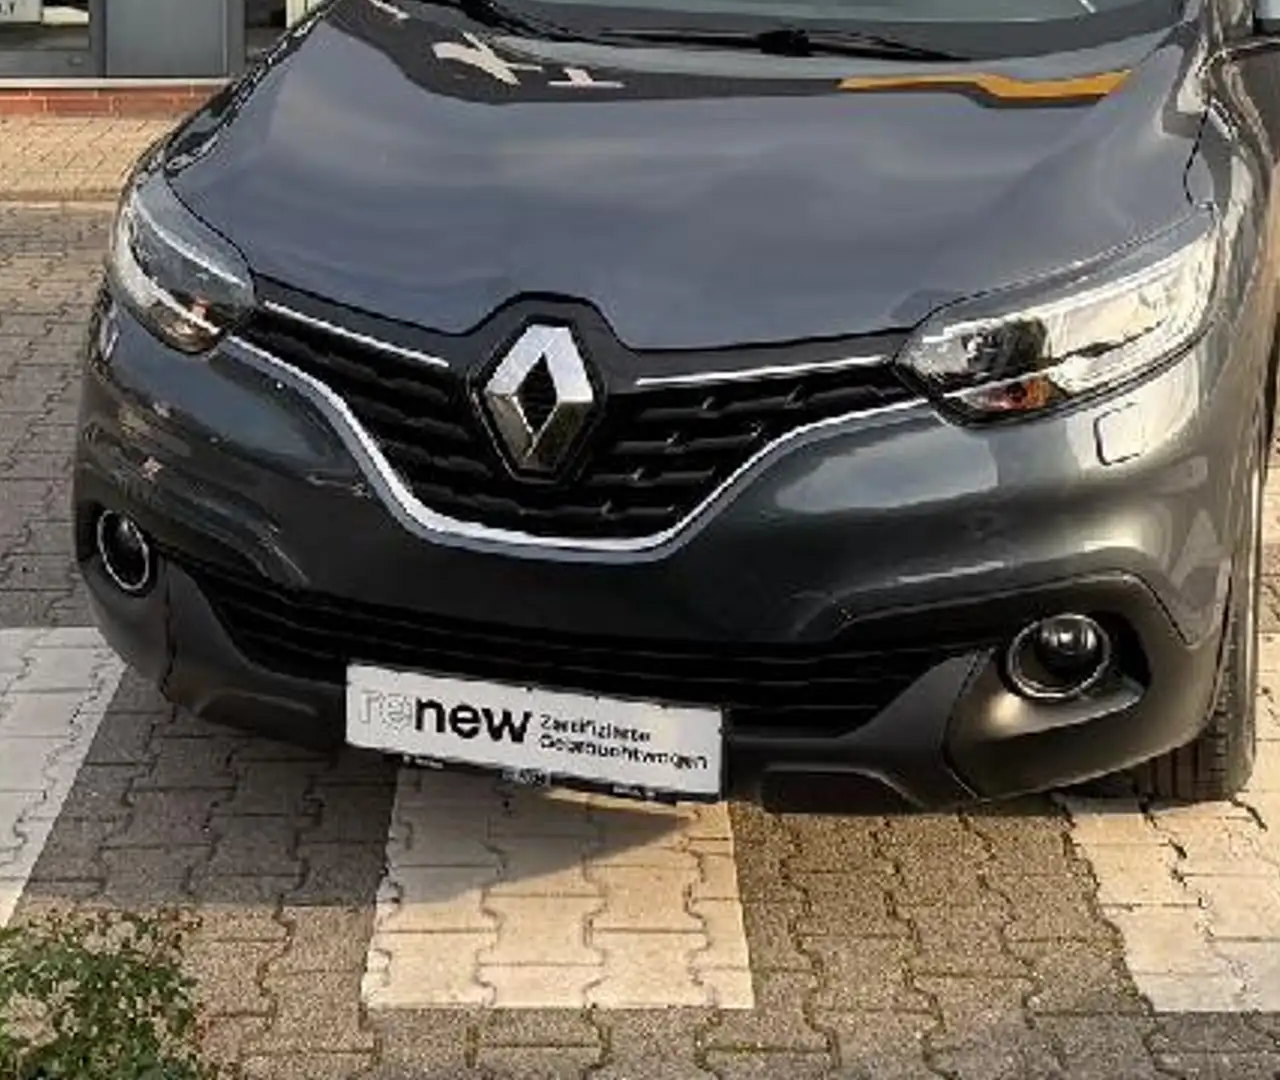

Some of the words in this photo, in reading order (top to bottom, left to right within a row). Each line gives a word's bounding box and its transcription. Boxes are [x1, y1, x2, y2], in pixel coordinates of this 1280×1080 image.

[358, 688, 533, 744] renew
[540, 713, 652, 742] Zertifizierte
[539, 735, 709, 771] Gebrauchtwagen
